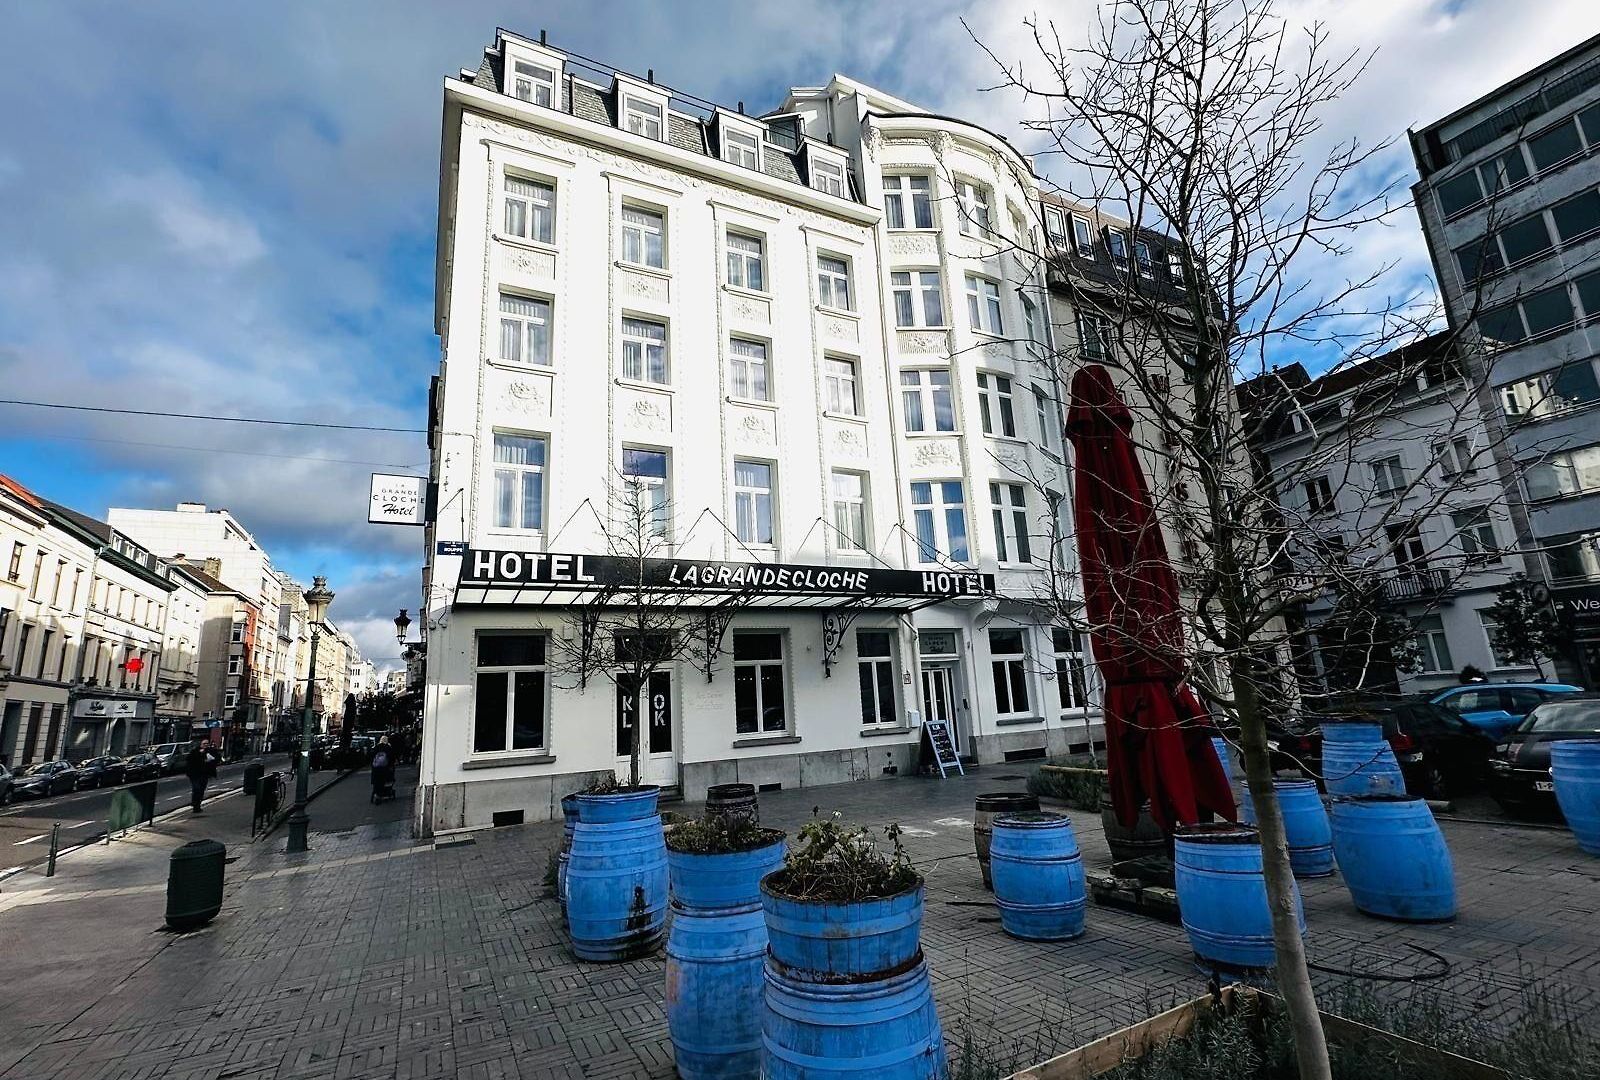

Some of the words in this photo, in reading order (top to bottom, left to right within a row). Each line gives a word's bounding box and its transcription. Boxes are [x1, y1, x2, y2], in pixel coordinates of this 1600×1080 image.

[381, 488, 417, 496] GRANDE
[372, 494, 425, 504] CLOCHE
[382, 503, 415, 516] Hotel
[473, 551, 595, 582] HOTEL
[922, 572, 992, 594] HOTEL
